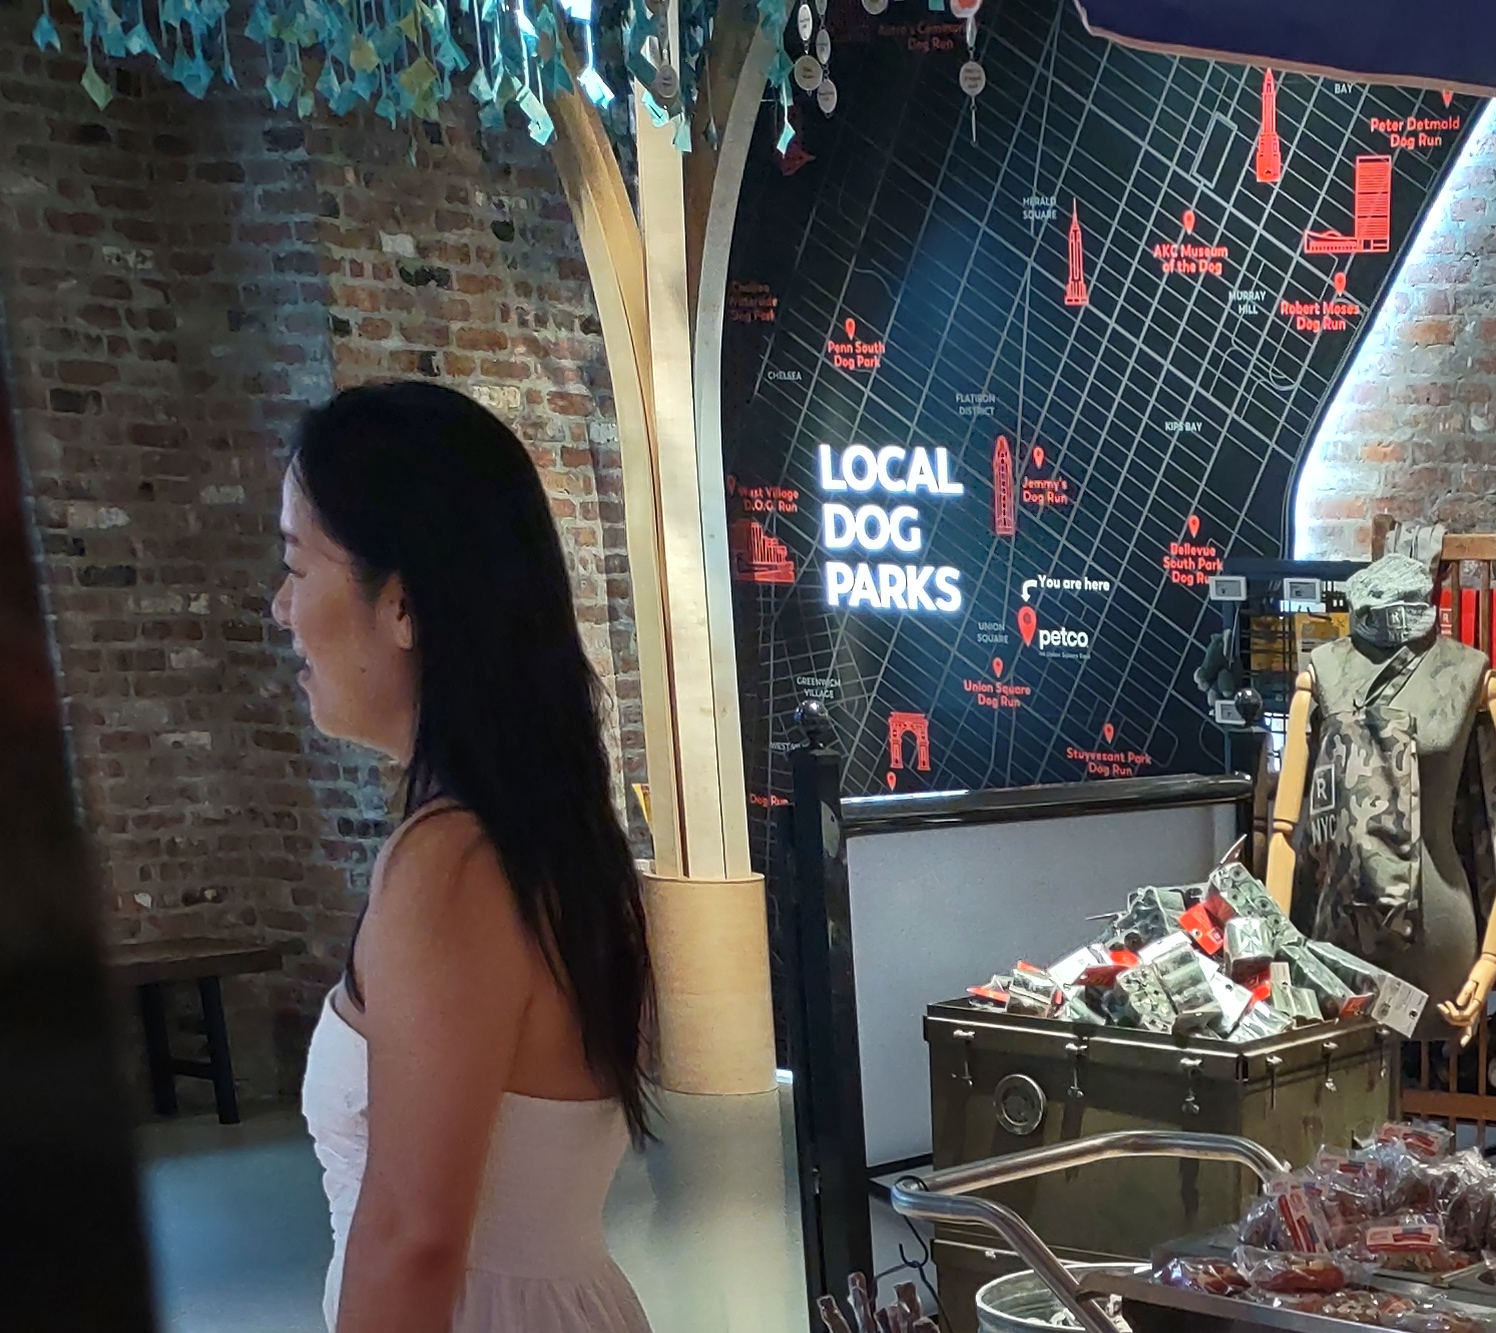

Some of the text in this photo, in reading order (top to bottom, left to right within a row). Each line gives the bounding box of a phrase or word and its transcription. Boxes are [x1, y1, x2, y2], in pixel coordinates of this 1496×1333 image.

[1334, 83, 1353, 94] BAY
[1370, 116, 1460, 132] Peter Detmold
[1390, 133, 1442, 149] Dog Run
[1023, 210, 1057, 220] SQUARE
[1153, 244, 1228, 258] AKC Museum
[1162, 259, 1222, 275] of the Dog
[1229, 291, 1266, 301] MURRAY
[1238, 304, 1258, 314] HILL
[1280, 301, 1359, 315] Robert Moses
[1296, 316, 1346, 332] Dog Run
[828, 341, 885, 354] Penn South
[834, 355, 880, 370] Dog Park
[959, 406, 995, 416] DISTRICT
[819, 443, 964, 494] LOCAL
[765, 486, 799, 500] Village
[1023, 490, 1068, 504] Dog Run
[779, 500, 798, 513] Run
[822, 503, 922, 551] DOG
[1170, 543, 1216, 557] Bellevue
[1163, 556, 1223, 571] South Park
[1038, 575, 1110, 591] You are here
[1172, 571, 1211, 586] Dog Ru
[825, 561, 962, 612] PARKS
[978, 622, 1005, 631] UNION
[977, 633, 1009, 645] SQUARE
[1039, 627, 1089, 650] petco
[796, 677, 841, 687] GREENWICH
[964, 679, 1031, 696] Union Square
[803, 690, 834, 699] VILLAGE
[978, 694, 1021, 709] Dog Run
[1067, 747, 1151, 764] Stuyvesant Park
[1088, 762, 1133, 777] Dog Run
[1316, 778, 1327, 800] R
[750, 794, 768, 807] Dog
[1311, 814, 1336, 846] NYC
